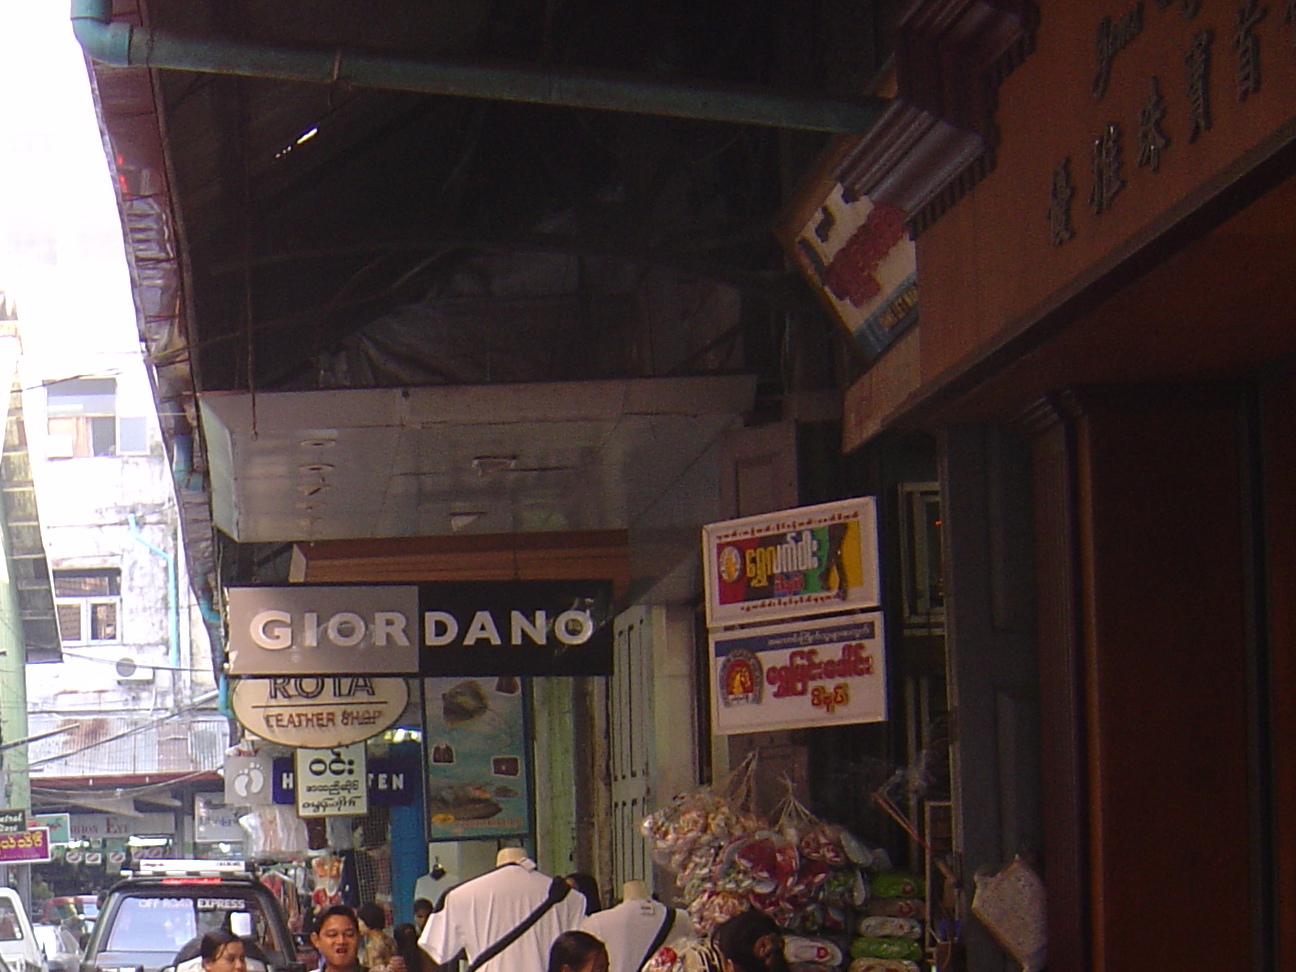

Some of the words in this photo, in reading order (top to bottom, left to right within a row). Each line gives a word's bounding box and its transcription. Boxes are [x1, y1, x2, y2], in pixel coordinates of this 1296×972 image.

[249, 610, 594, 650] GIORDANO
[266, 711, 335, 729] LEATHER
[196, 898, 245, 909] EXPRESS
